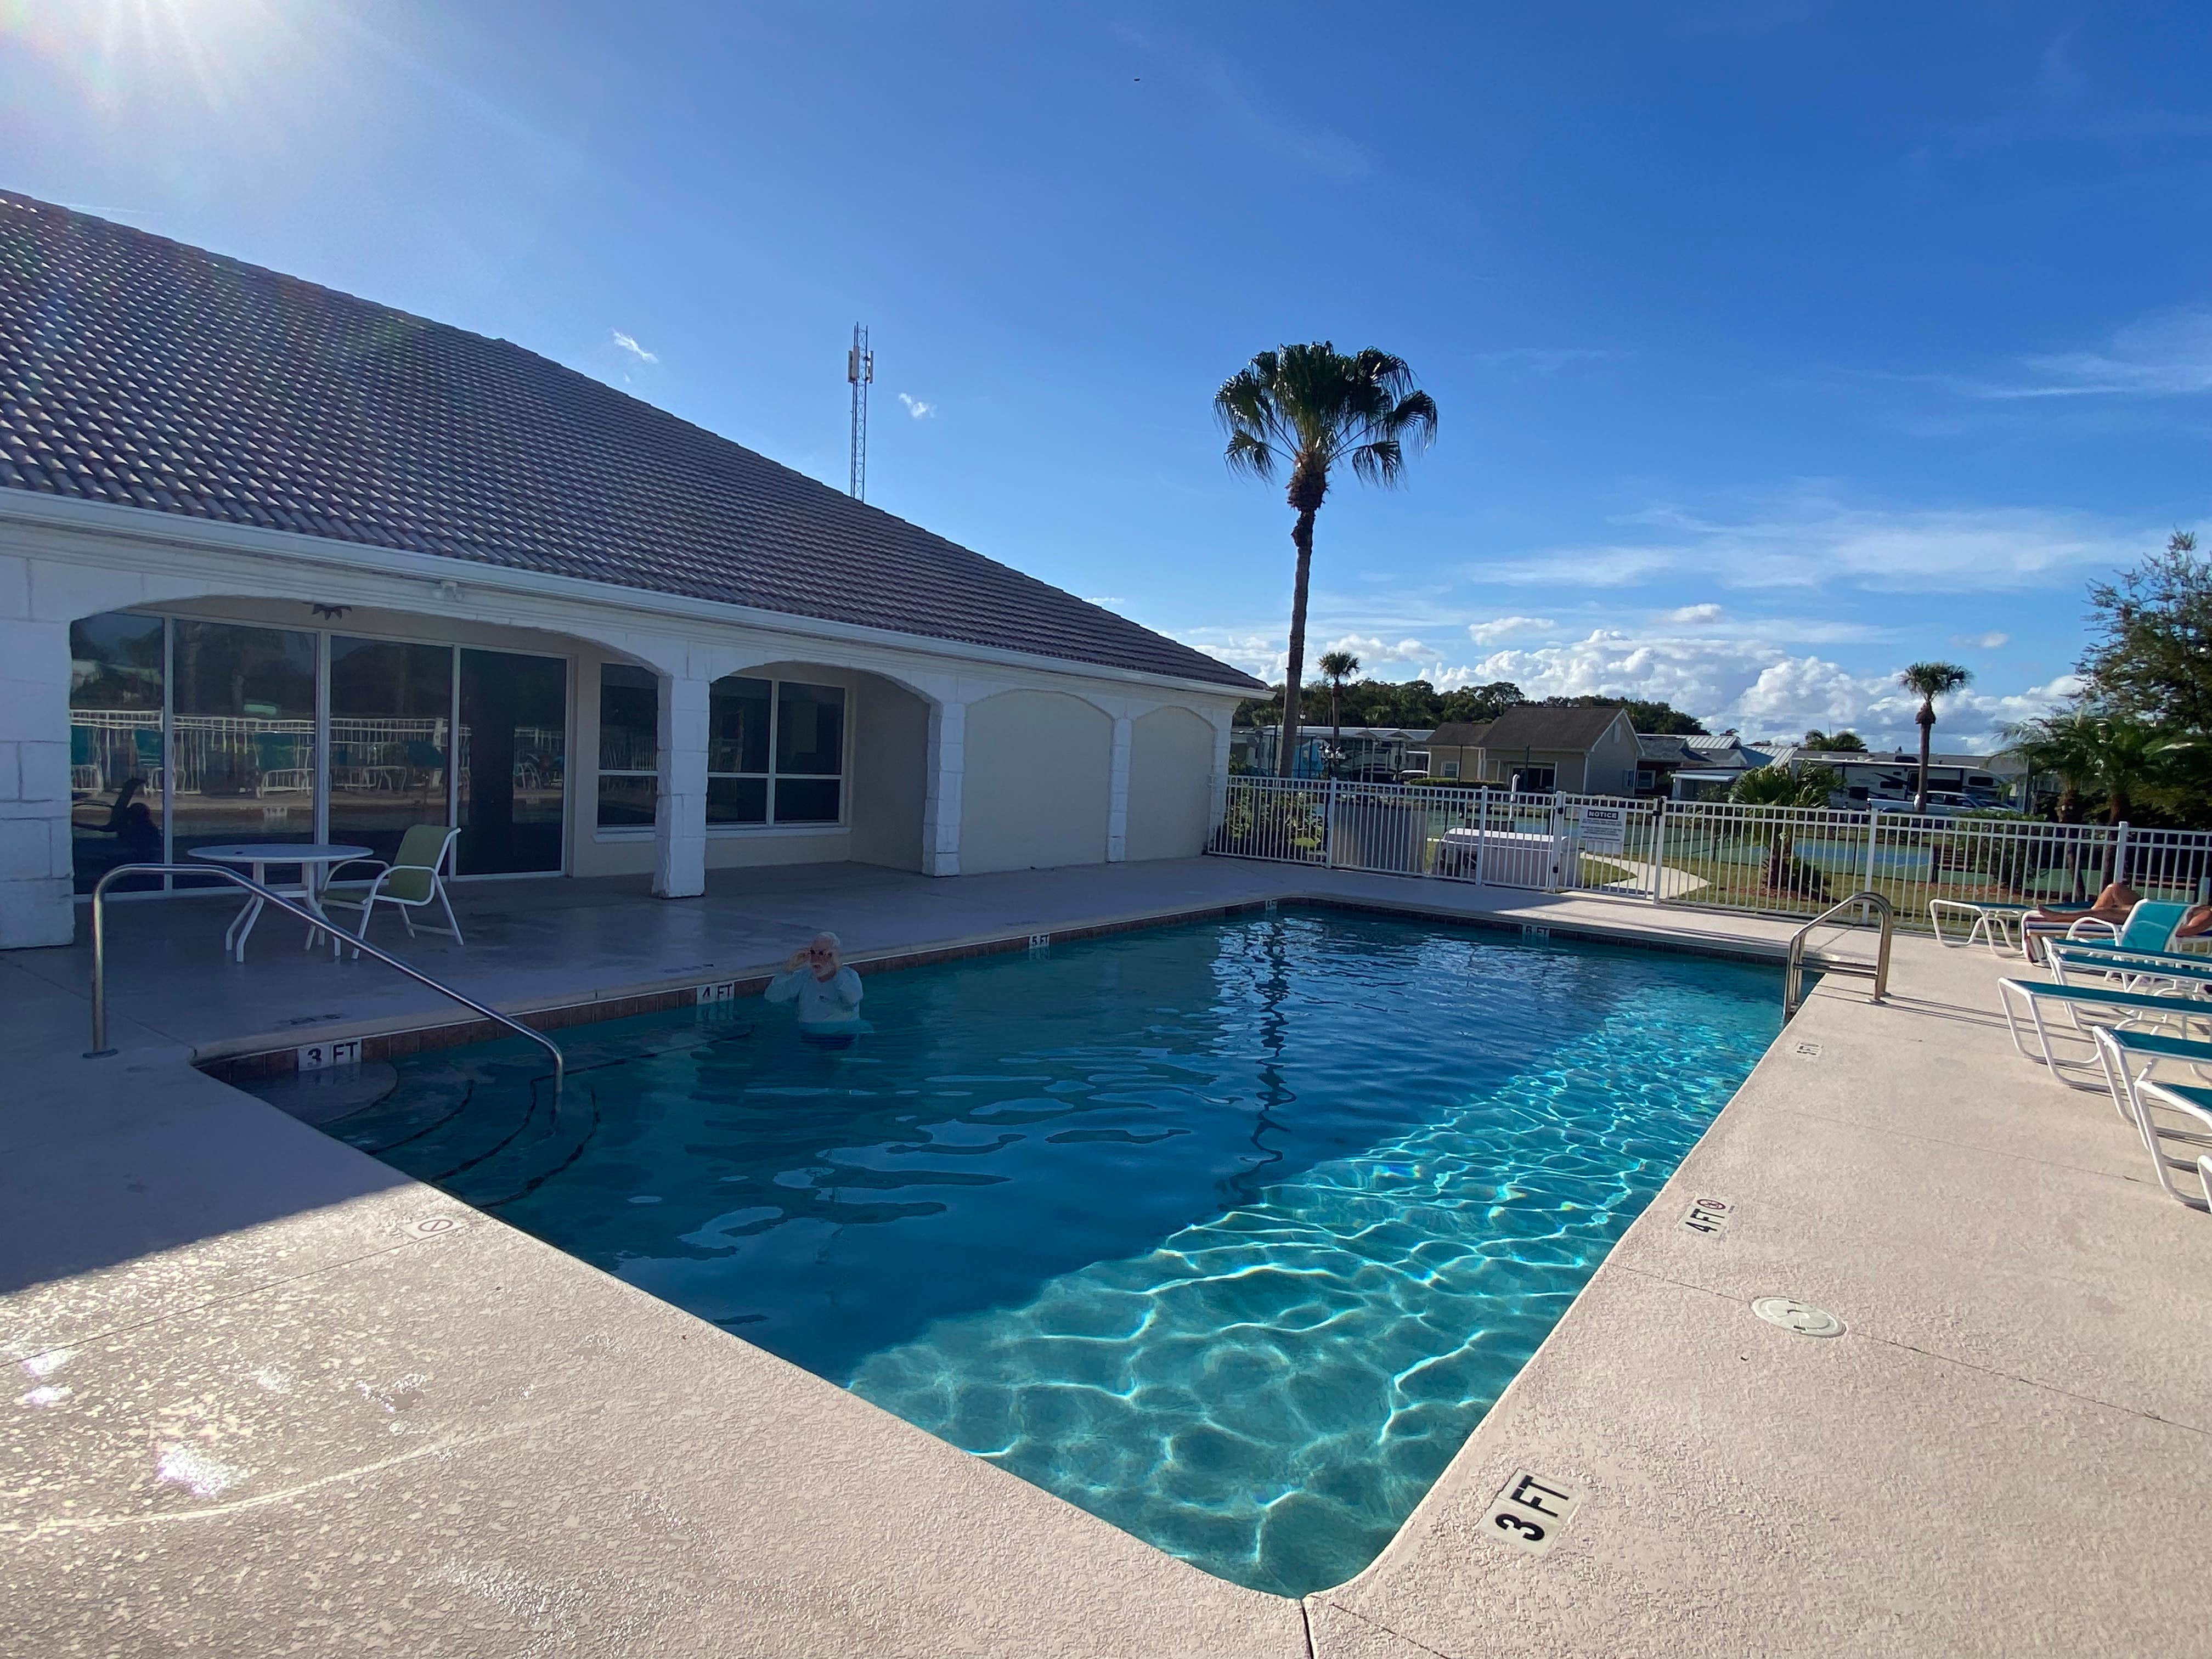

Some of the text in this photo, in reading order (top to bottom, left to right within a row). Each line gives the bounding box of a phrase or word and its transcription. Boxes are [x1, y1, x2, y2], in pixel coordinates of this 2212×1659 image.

[1588, 811, 1617, 819] NOTICE
[1032, 934, 1048, 946] 5 FT
[717, 983, 732, 1000] FT
[307, 1042, 358, 1065] 3 FT
[1685, 1208, 1725, 1233] 4 FT
[1495, 1475, 1569, 1541] 3 FT
